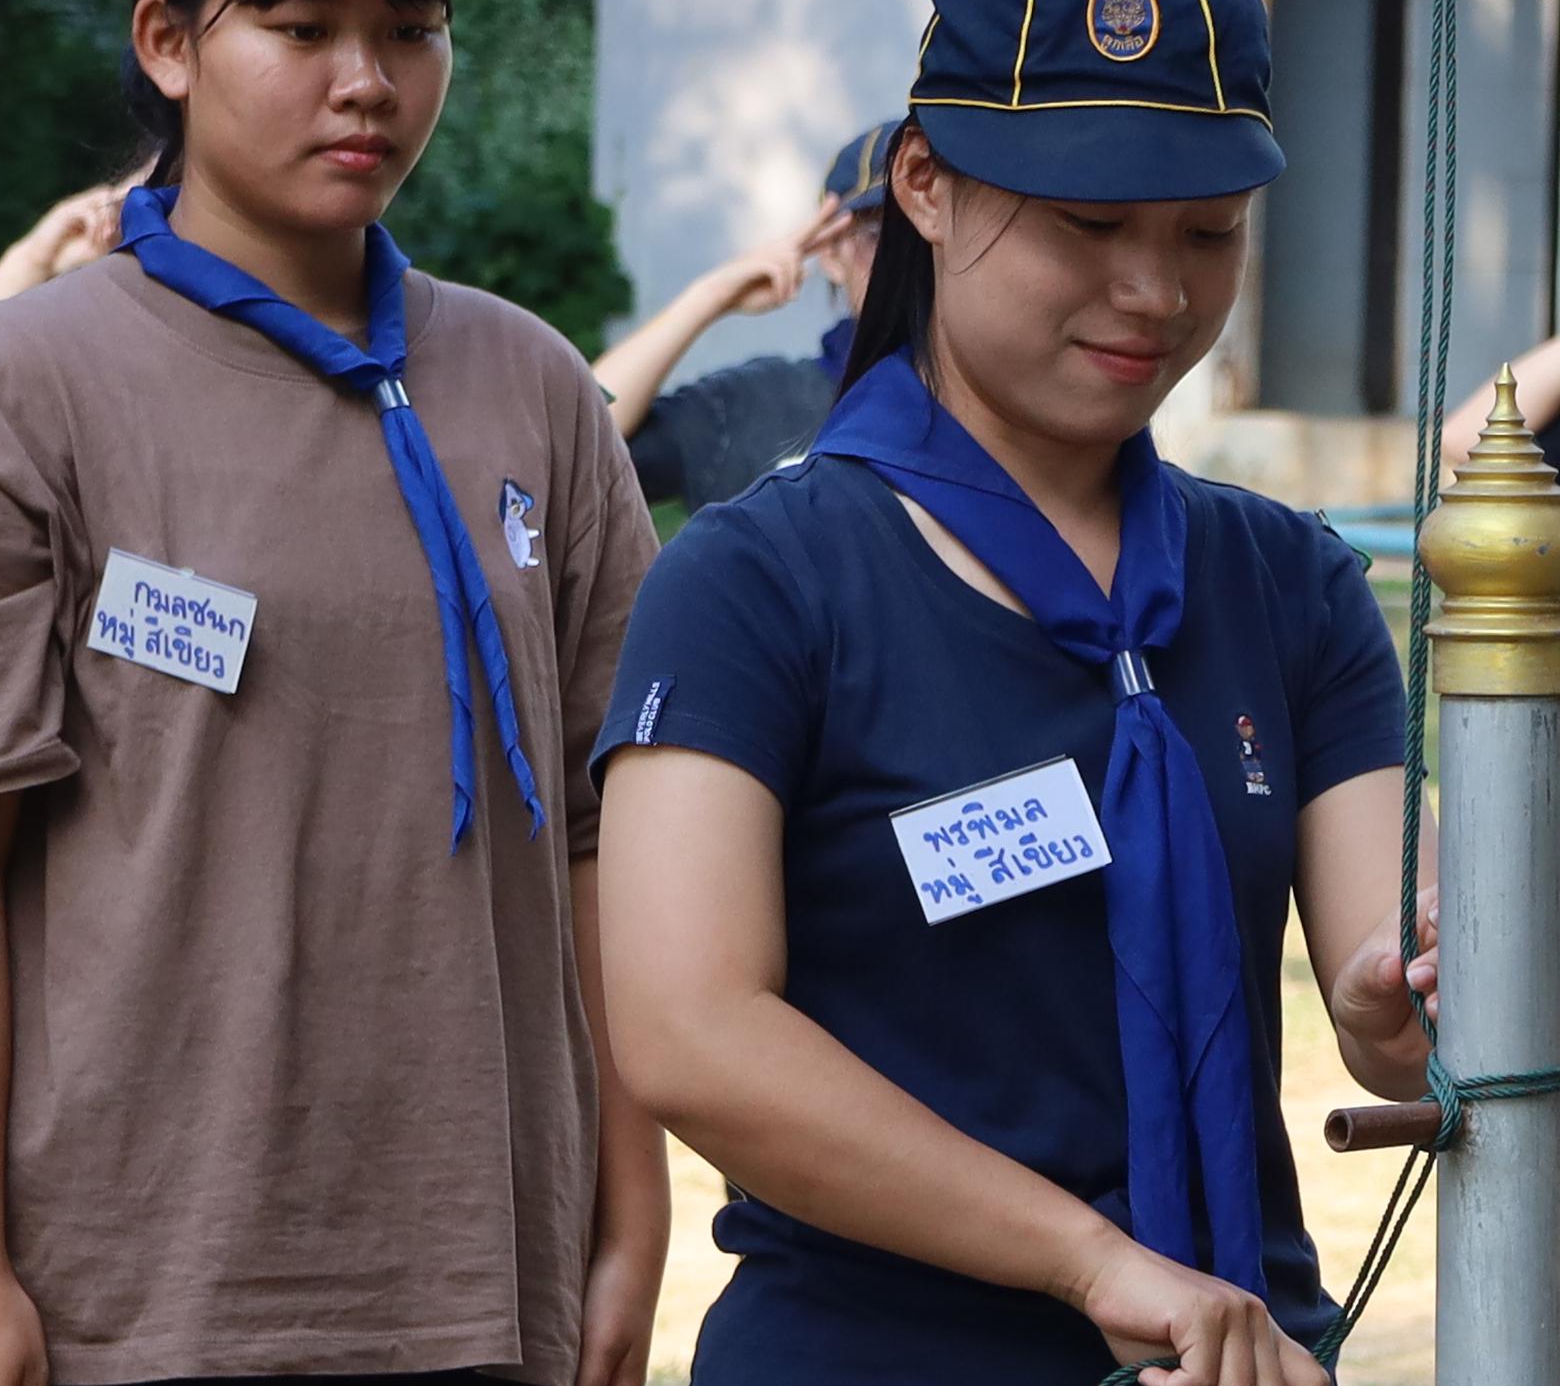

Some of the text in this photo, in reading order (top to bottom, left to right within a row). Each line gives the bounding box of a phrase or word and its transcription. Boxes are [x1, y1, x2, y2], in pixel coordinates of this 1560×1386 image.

[97, 608, 225, 679] หมู่ สีเขียว
[134, 581, 246, 642] กมลชนก
[922, 798, 1048, 853] พรพิมล
[921, 831, 1093, 904] หมู่ สีเขียว
